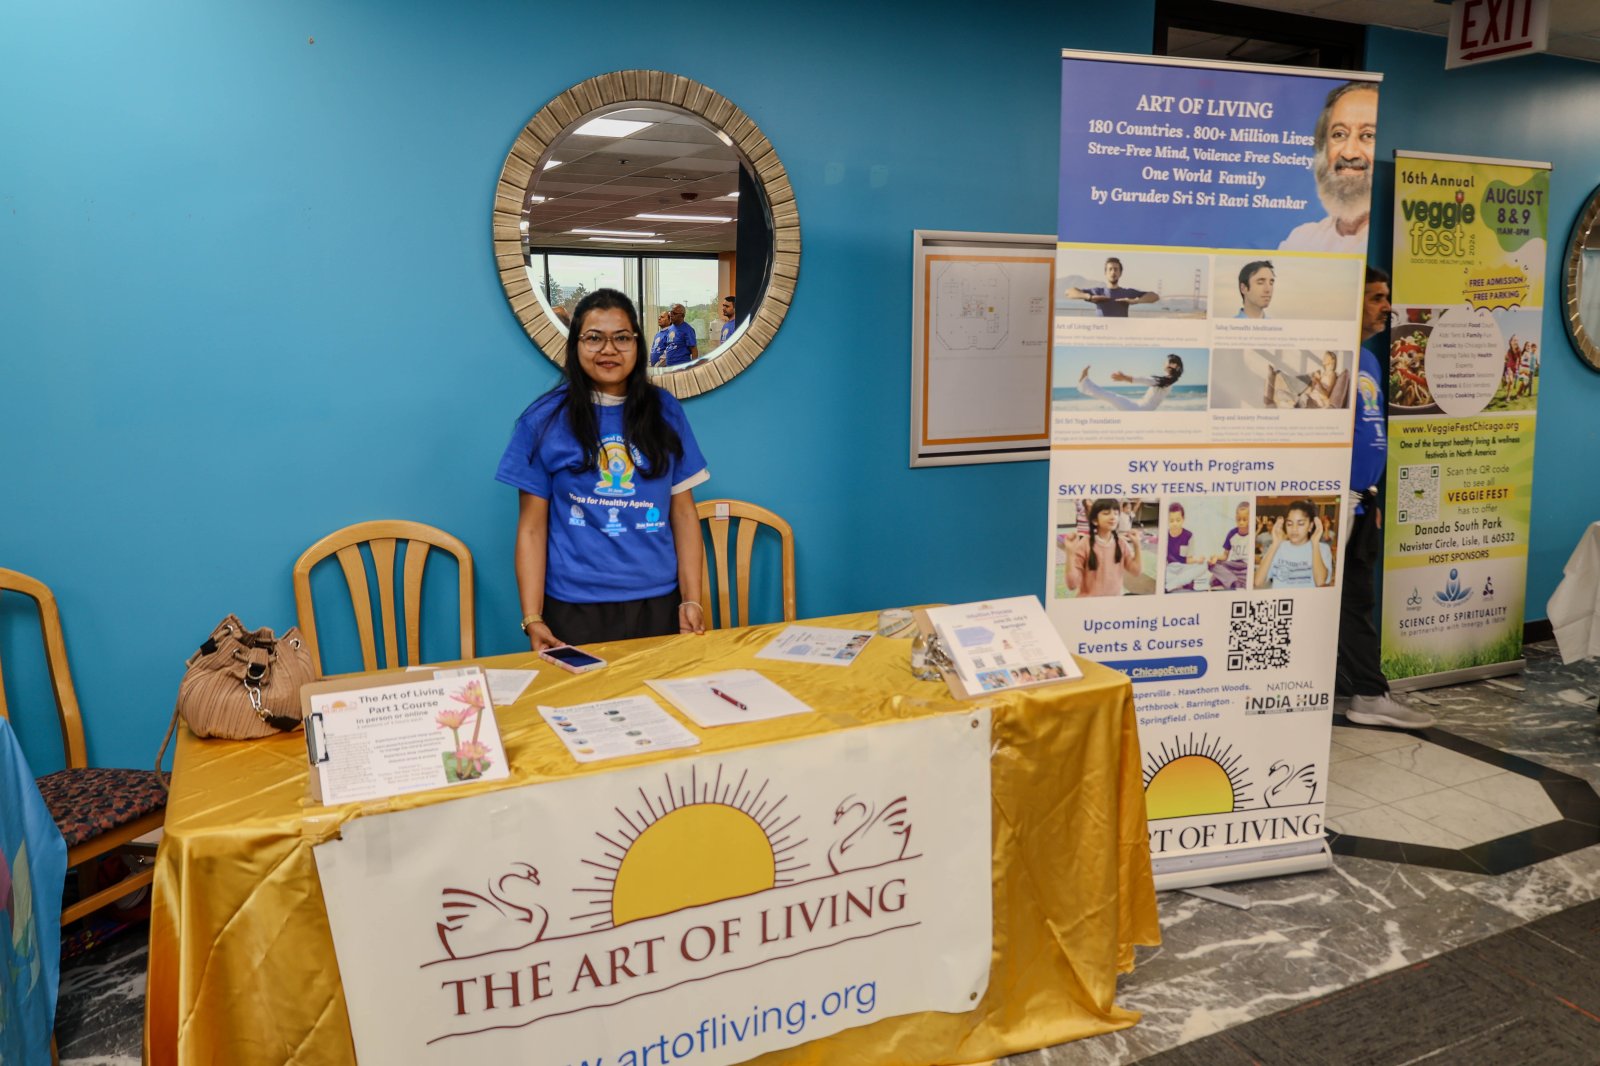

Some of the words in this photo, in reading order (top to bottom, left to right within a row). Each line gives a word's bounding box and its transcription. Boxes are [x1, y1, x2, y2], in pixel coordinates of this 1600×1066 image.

[1461, 0, 1532, 50] EXIT
[1136, 95, 1175, 113] ART
[1178, 97, 1204, 115] OF
[1206, 100, 1274, 119] LIVING
[1088, 119, 1113, 134] 180
[1116, 121, 1183, 138] Countries
[1193, 126, 1227, 141] 800+
[1230, 128, 1278, 144] Million
[1282, 131, 1315, 146] Lives
[1088, 141, 1152, 158] Stree-Free
[1155, 145, 1190, 161] Mind,
[1193, 148, 1241, 163] Voilence
[1244, 151, 1270, 164] Free
[1272, 152, 1314, 169] Society
[1142, 167, 1169, 182] One
[1173, 168, 1212, 184] World
[1218, 171, 1266, 189] Family
[1402, 171, 1427, 185] 16th
[1431, 173, 1474, 187] Annual
[1091, 187, 1108, 205] by
[1111, 188, 1169, 204] Gurudev
[1173, 190, 1193, 205] Sri
[1196, 191, 1216, 206] Sri
[1218, 193, 1249, 208] Ravi
[1252, 195, 1307, 210] Shankar
[1485, 188, 1543, 206] AUGUST
[1402, 199, 1475, 229] veggie
[1497, 208, 1505, 223] 8
[1509, 208, 1518, 224] &
[1522, 209, 1531, 224] 9
[1410, 222, 1465, 256] fest
[1469, 279, 1485, 287] FREE
[1487, 277, 1523, 286] ADMISSION
[1473, 293, 1488, 301] FREE
[1490, 291, 1519, 299] PARKING
[1403, 422, 1519, 435] www.VeggieFestChicago.org
[1400, 440, 1413, 449] One
[1415, 440, 1421, 448] of
[1422, 439, 1431, 448] the
[1433, 438, 1452, 449] largest
[1453, 437, 1474, 447] healthy
[1475, 437, 1490, 447] living
[1498, 436, 1520, 444] wellness
[1425, 451, 1447, 459] festivals
[1457, 450, 1472, 458] North
[1128, 460, 1158, 473] SKY
[1162, 460, 1204, 472] Youth
[1208, 459, 1274, 475] Programs
[1446, 468, 1464, 477] Scan
[1466, 467, 1478, 475] the
[1479, 466, 1491, 474] QR
[1492, 464, 1510, 473] code
[1058, 484, 1086, 496] SKY
[1090, 484, 1126, 496] KIDS,
[1130, 483, 1158, 495] SKY
[1162, 482, 1207, 494] TEENS,
[1212, 481, 1276, 492] INTUITION
[1280, 480, 1341, 492] PROCESS
[1463, 480, 1471, 488] to
[1487, 478, 1495, 486] all
[569, 492, 586, 503] Yoga
[587, 496, 598, 505] for
[599, 498, 628, 508] Healthy
[629, 500, 654, 508] Ageing
[1448, 491, 1484, 502] VEGGIE
[1486, 489, 1509, 499] FEST
[1458, 506, 1470, 515] has
[1472, 506, 1479, 514] to
[1481, 504, 1498, 513] offer
[1415, 521, 1450, 536] Danada
[1454, 520, 1479, 532] South
[1482, 517, 1502, 529] Park
[1400, 541, 1432, 552] Navistar
[1435, 538, 1459, 549] Circle,
[1462, 536, 1480, 547] Lisle,
[1483, 535, 1488, 544] IL
[1492, 533, 1515, 543] 60532
[1429, 554, 1449, 564] HOST
[1451, 550, 1489, 562] SPONSORS
[1083, 617, 1158, 634] Upcoming
[1162, 613, 1200, 627] Local
[1399, 616, 1435, 628] SCIENCE
[1439, 613, 1450, 623] OF
[1454, 607, 1507, 622] SPIRITUALITY
[1078, 640, 1128, 655] Events
[1133, 639, 1142, 651] &
[1147, 638, 1204, 650] Courses
[1133, 689, 1171, 700] aperville
[1178, 686, 1219, 697] Hawthorn
[1267, 680, 1314, 692] NATIONAL
[358, 696, 379, 704] The
[381, 692, 398, 702] Art
[400, 691, 411, 699] of
[414, 687, 445, 697] Living
[1297, 692, 1329, 707] HUB
[369, 705, 391, 715] Part
[402, 700, 438, 711] Course
[1137, 702, 1179, 713] orthbrook
[1186, 697, 1230, 709] Barrington
[366, 714, 393, 724] person
[405, 710, 428, 718] online
[1140, 715, 1187, 727] Springfield
[1193, 711, 1220, 722] Online
[1179, 824, 1217, 850] OF
[1224, 813, 1322, 846] LIVING
[441, 961, 555, 1017] THE
[570, 936, 666, 993] ART
[679, 915, 742, 962] OF
[760, 877, 910, 946] LIVING
[563, 981, 877, 1066] artofliving.org
